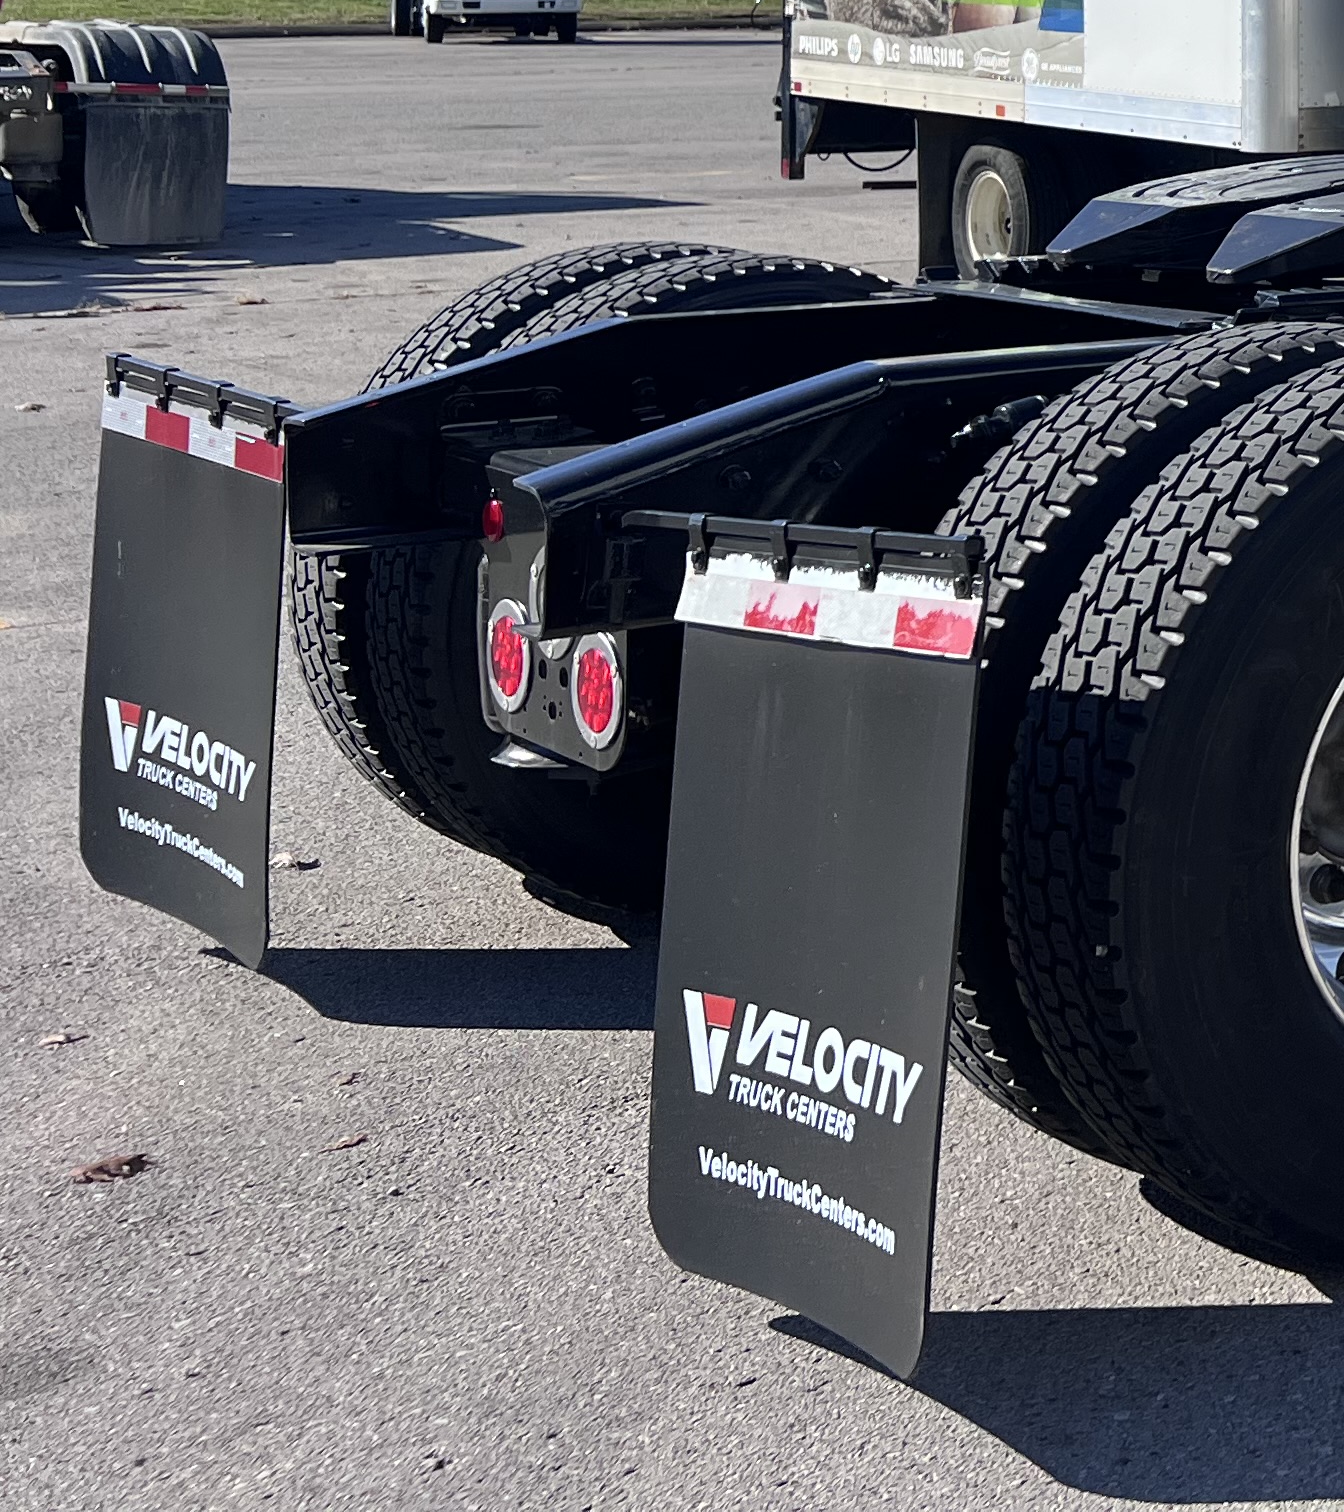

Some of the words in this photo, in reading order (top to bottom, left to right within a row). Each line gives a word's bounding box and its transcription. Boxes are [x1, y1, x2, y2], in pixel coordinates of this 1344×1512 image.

[799, 35, 839, 57] PHILIPS
[886, 43, 900, 63] LG
[909, 44, 964, 69] SAMSUNG
[137, 758, 175, 789] TRUCK
[175, 774, 218, 811] CENTERS
[142, 710, 257, 802] VELOCITY
[118, 807, 244, 889] VelocityTruckCenters.com
[736, 1003, 924, 1125] VELOCITY
[728, 1073, 785, 1115] TRUCK
[786, 1091, 856, 1143] CENTERS
[698, 1145, 896, 1256] VelocityTruckCenters.com
